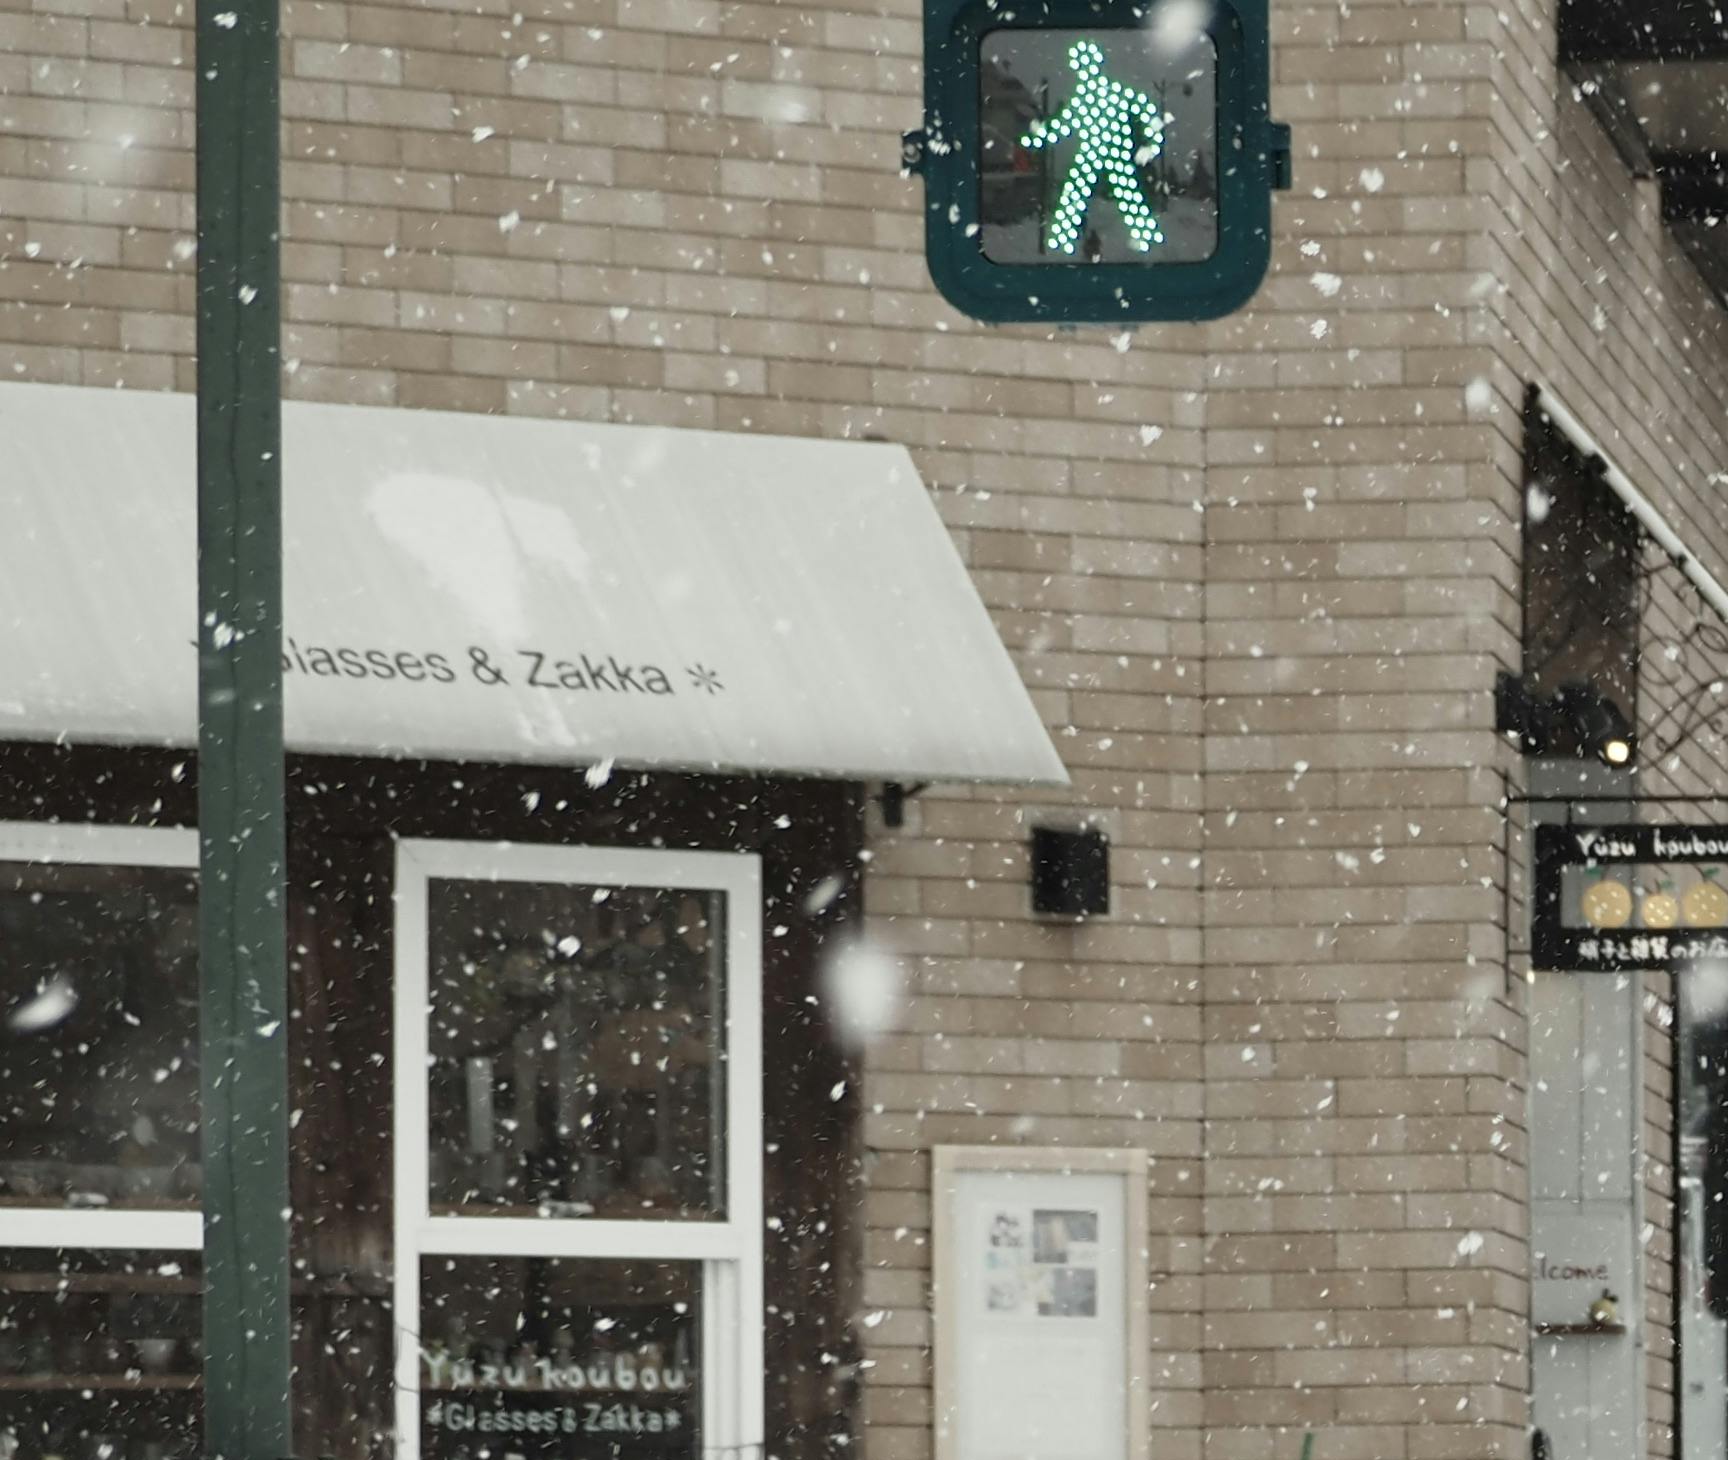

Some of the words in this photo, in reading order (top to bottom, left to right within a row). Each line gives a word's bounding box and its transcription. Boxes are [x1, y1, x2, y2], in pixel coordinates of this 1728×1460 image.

[467, 646, 507, 686] &
[518, 650, 675, 695] Zakka
[1576, 833, 1637, 857] Yuzu
[419, 1346, 528, 1389] Yuzu
[536, 1353, 687, 1390] koubou
